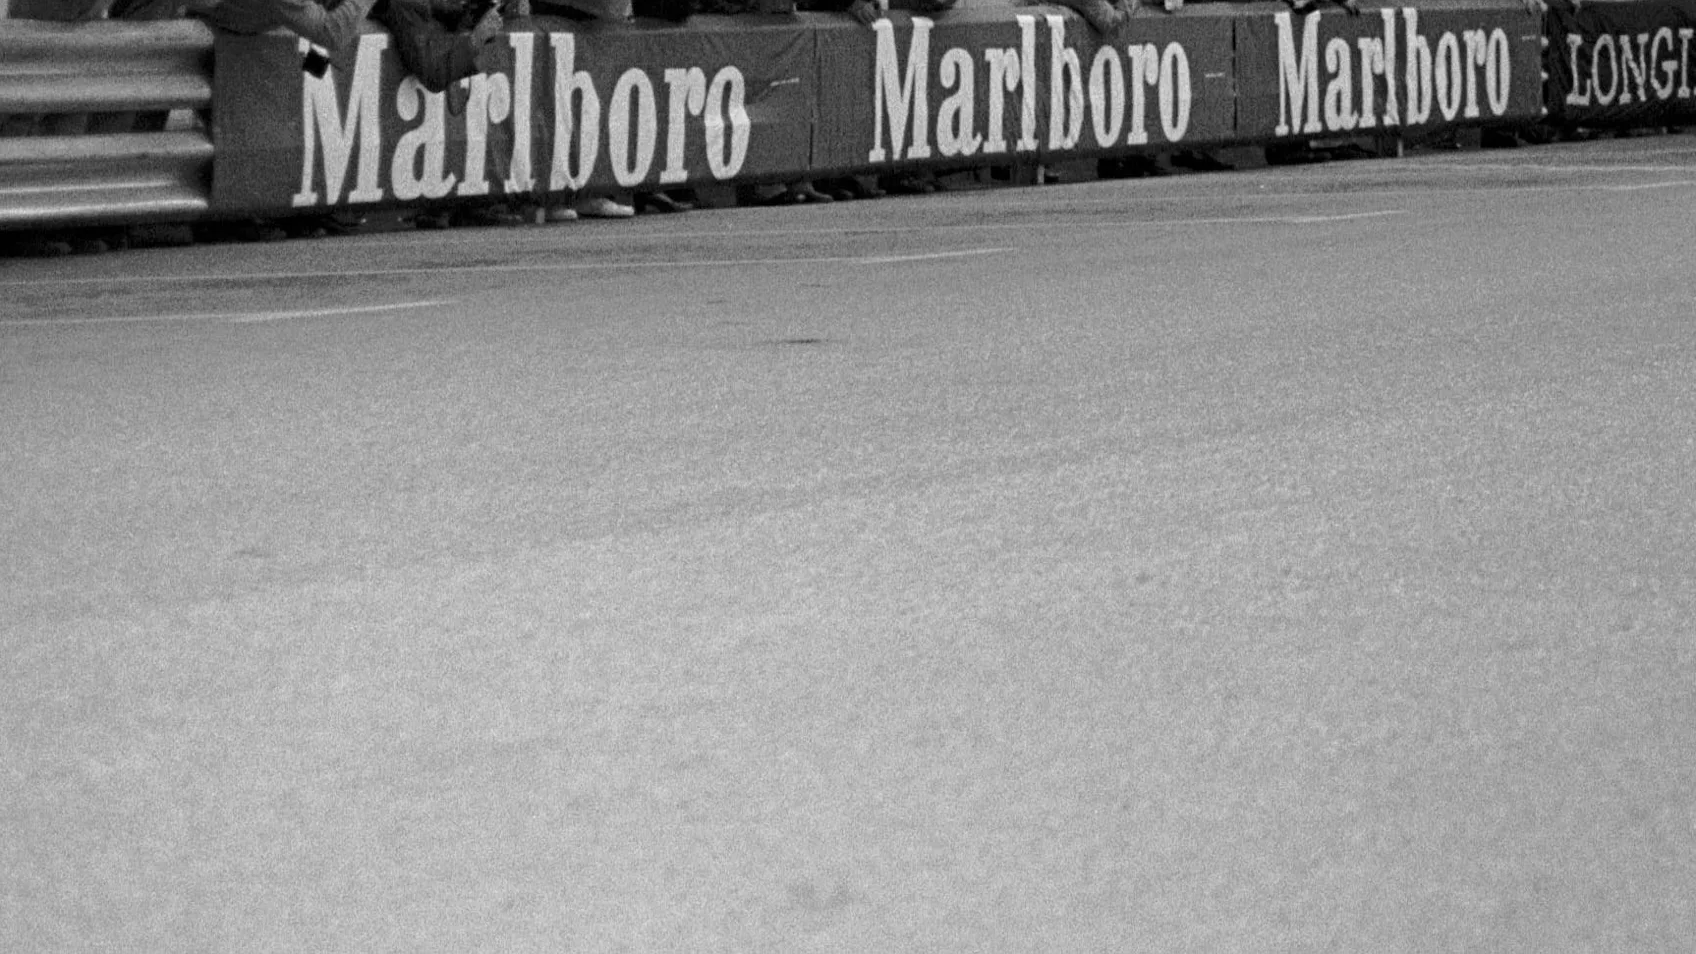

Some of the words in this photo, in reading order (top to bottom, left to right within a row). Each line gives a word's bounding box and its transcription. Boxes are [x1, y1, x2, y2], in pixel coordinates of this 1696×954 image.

[291, 31, 752, 208] Marlboro
[868, 13, 1192, 163] Marlboro
[1273, 7, 1511, 137] Marlboro
